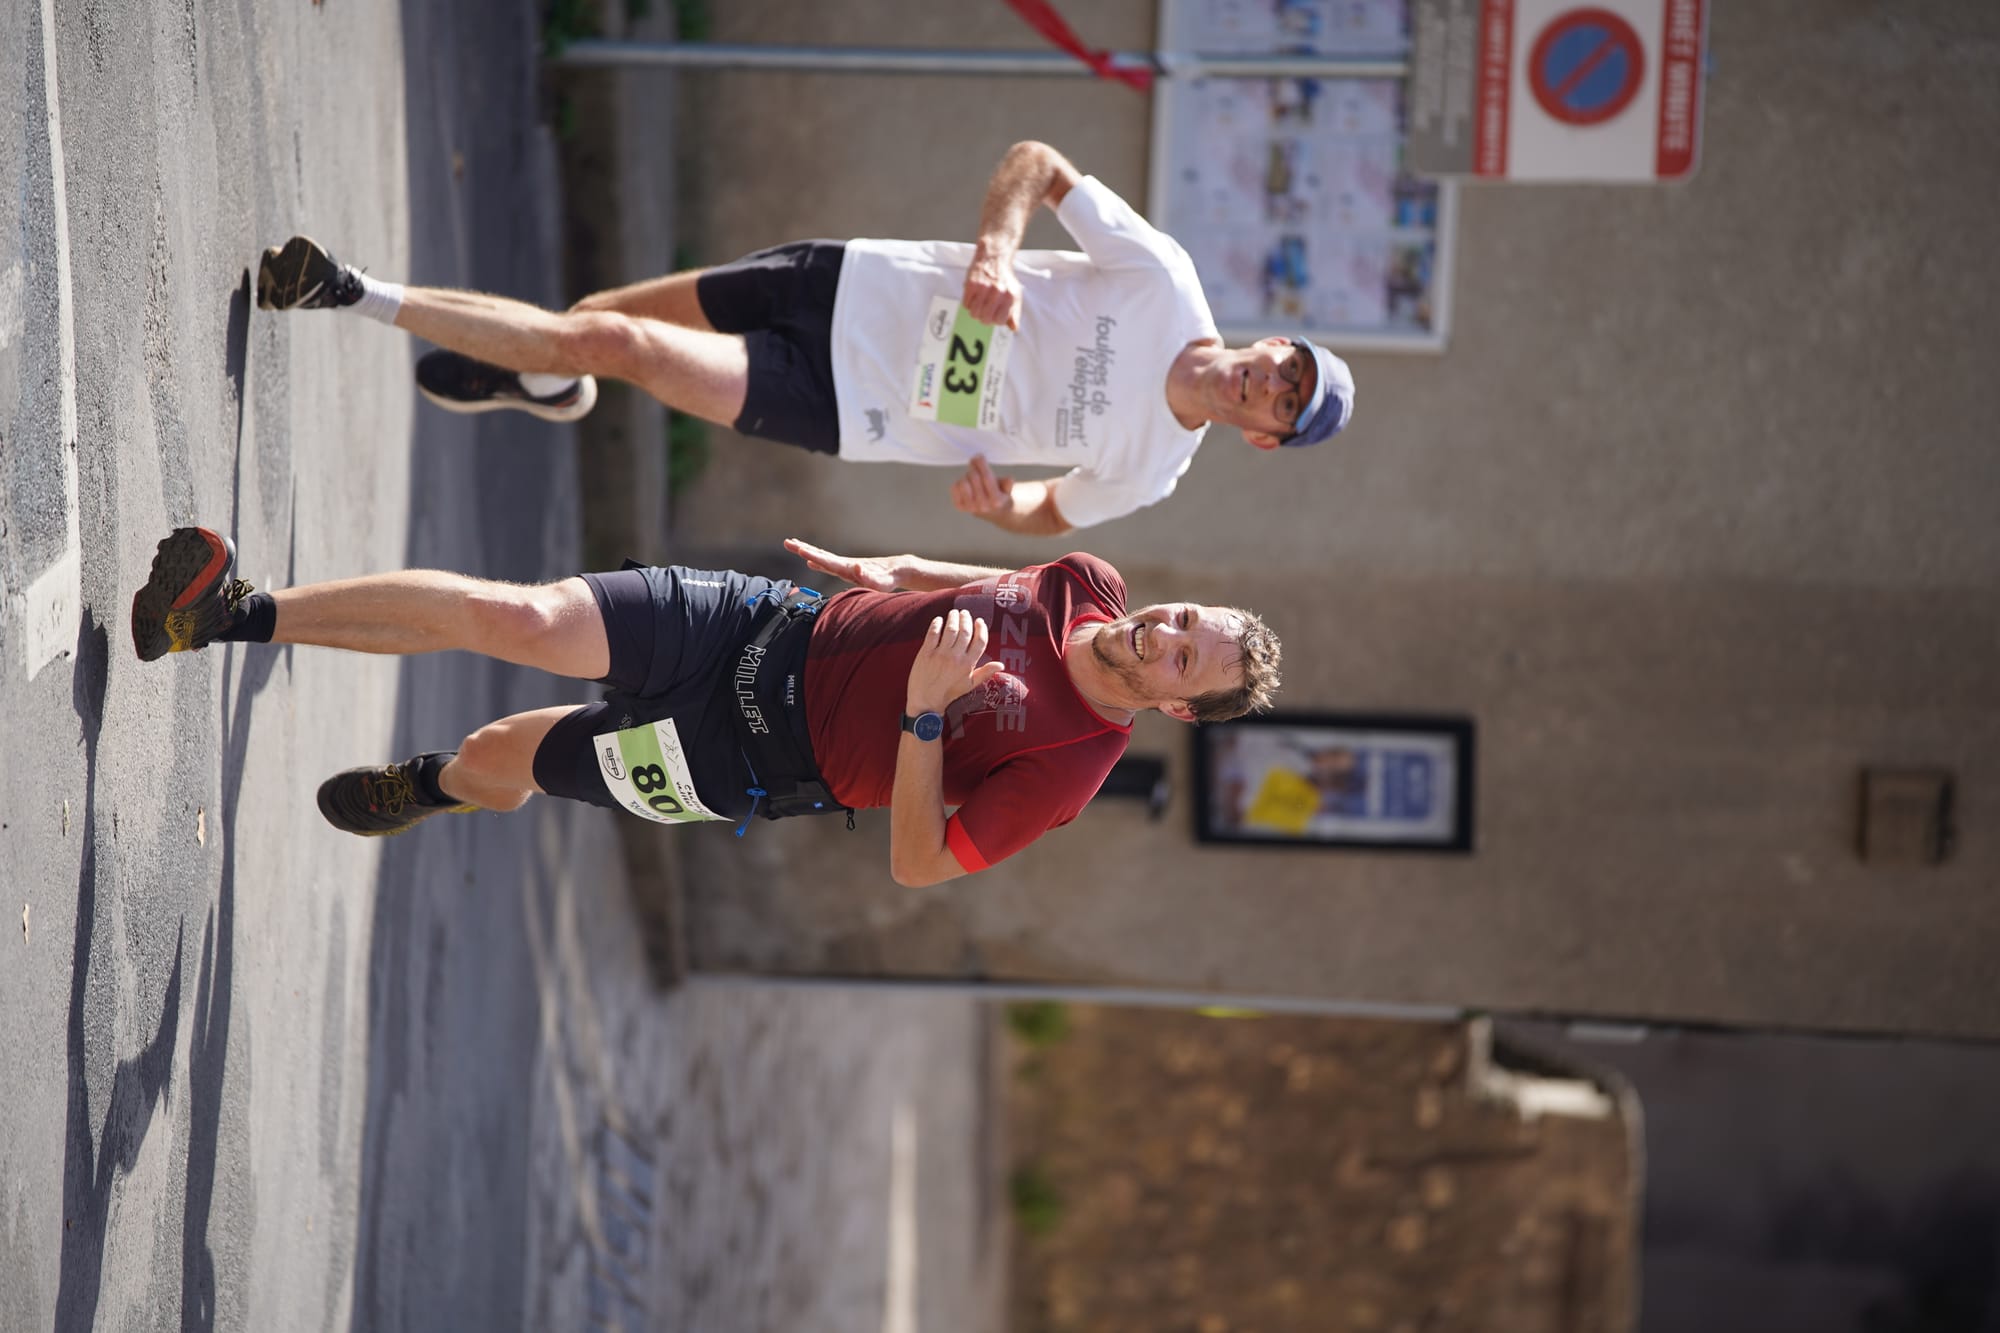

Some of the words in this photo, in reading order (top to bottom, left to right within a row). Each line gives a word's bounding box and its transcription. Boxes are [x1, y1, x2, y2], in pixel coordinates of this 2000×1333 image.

[944, 334, 984, 395] 23
[1093, 315, 1117, 386] foulées
[1090, 390, 1112, 416] de
[734, 645, 769, 734] MILLET
[786, 675, 795, 706] MILLET
[605, 747, 619, 777] BFP
[631, 763, 684, 814] 80
